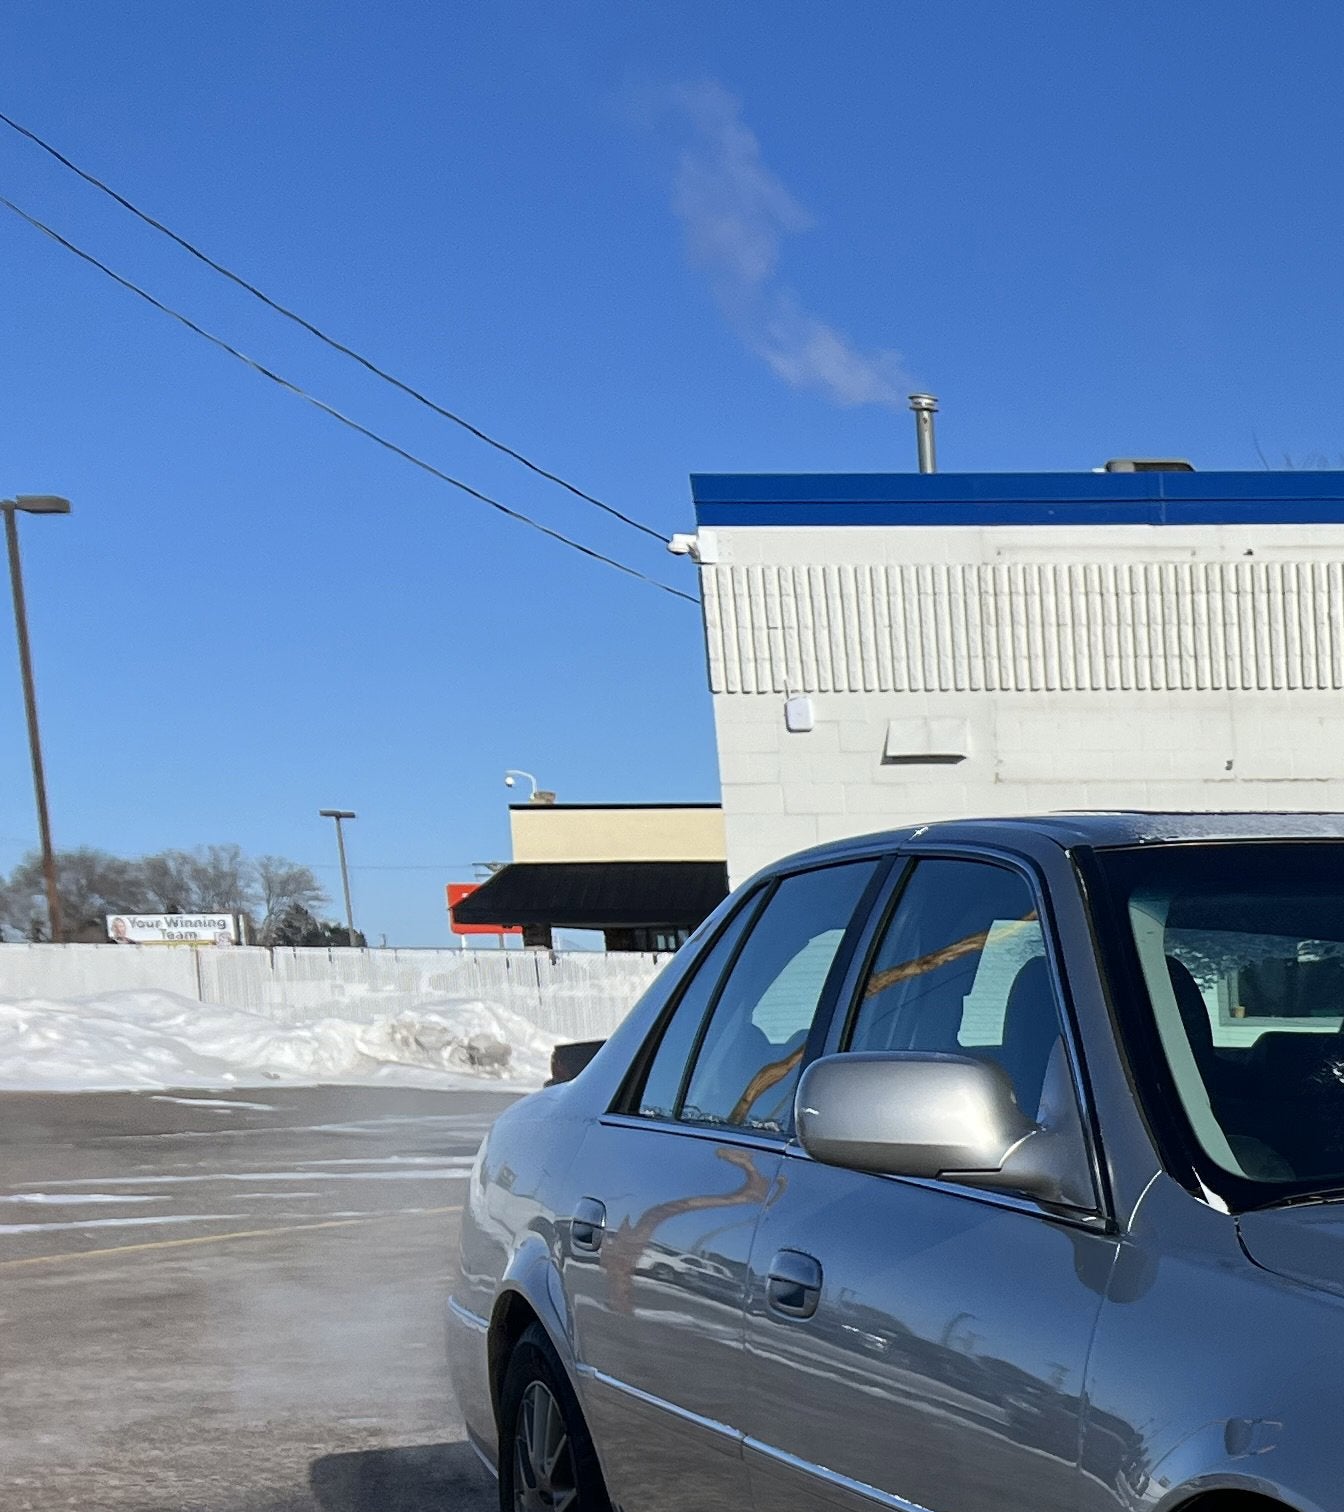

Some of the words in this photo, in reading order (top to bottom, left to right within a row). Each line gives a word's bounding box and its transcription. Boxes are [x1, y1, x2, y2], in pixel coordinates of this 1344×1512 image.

[128, 916, 161, 929] Your
[164, 915, 226, 930] Winning
[161, 929, 198, 940] Team
